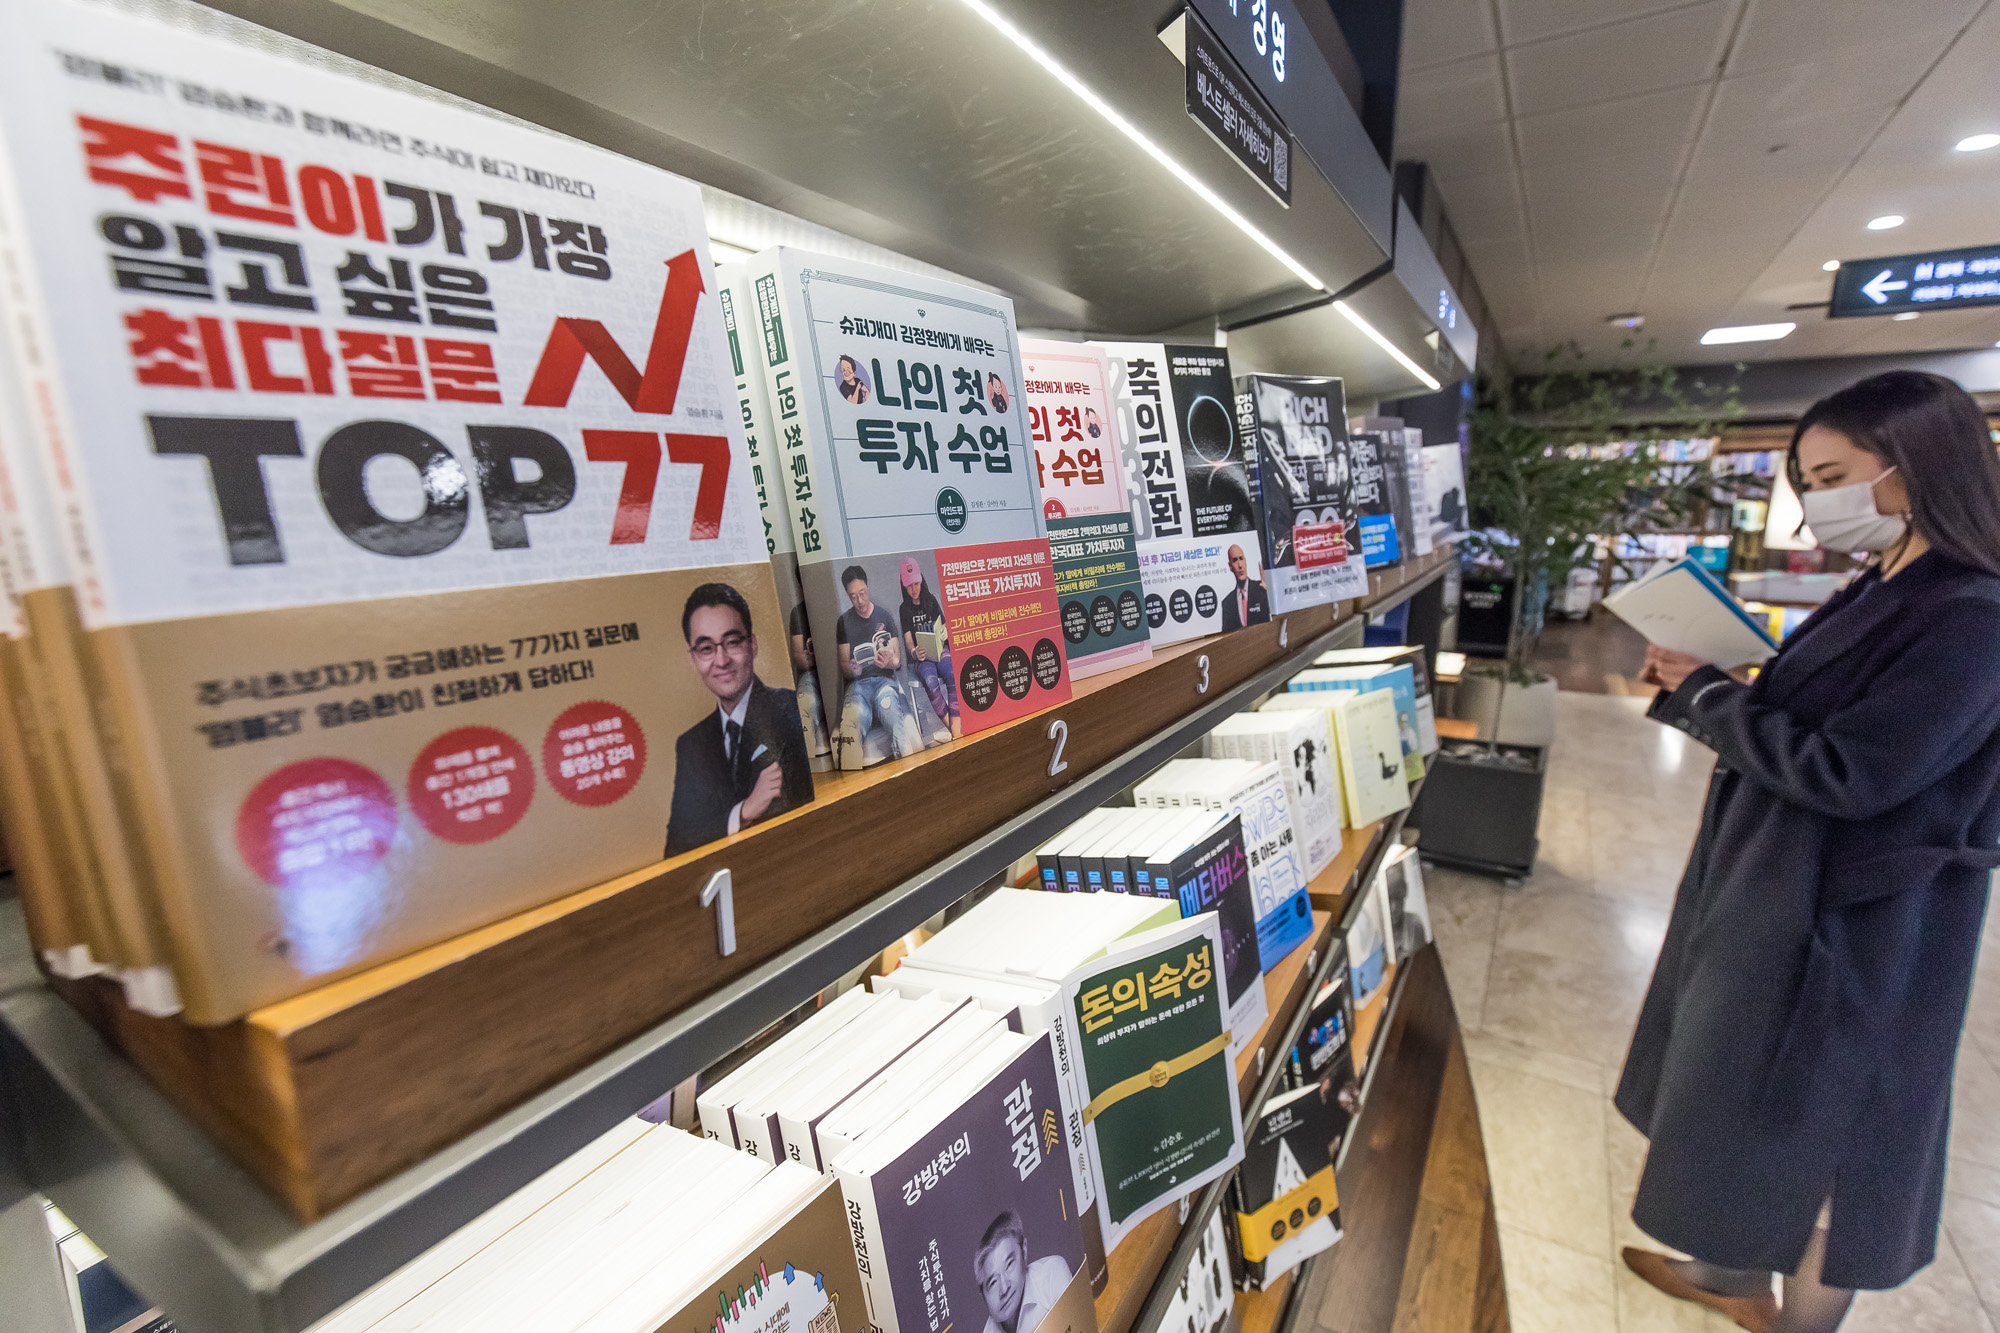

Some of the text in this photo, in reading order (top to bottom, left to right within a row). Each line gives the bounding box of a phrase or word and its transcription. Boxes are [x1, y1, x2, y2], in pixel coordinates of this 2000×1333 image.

[1197, 70, 1238, 139] 베스트셀러
[301, 110, 404, 155] 함께라면
[409, 137, 476, 170] 주식이
[480, 156, 521, 182] 쉽고
[523, 166, 596, 200] 재미있다
[75, 112, 613, 281] 주린이가 가장
[98, 212, 499, 332] 알고 싶은
[720, 292, 735, 331] 슈퍼개미
[765, 275, 780, 317] 슈퍼개미
[839, 315, 995, 358] 슈퍼개미 김정환에게 배우는
[122, 308, 503, 405] 최다질문
[871, 357, 988, 417] 나의 첫
[1064, 382, 1091, 395] 배우는
[1056, 406, 1084, 442] 첫
[1280, 396, 1329, 424] RICH
[775, 370, 822, 553] 나의 첫 투자 수업
[856, 418, 939, 475] 투자
[948, 425, 1013, 475] 수업
[1127, 358, 1183, 538] 축의 전환
[1052, 448, 1105, 487] 수업
[940, 504, 964, 517] 마인드편
[947, 495, 953, 504] 1
[1195, 504, 1232, 515] THE FUTURE OF
[1197, 513, 1229, 525] EVERYTHING
[1050, 538, 1125, 560] 한국대표 가치투자자
[1080, 526, 1102, 536] 2백억대
[1102, 524, 1118, 535] 자산을
[941, 552, 1046, 577] 7천만원으로 2백억대 자산을 이룬
[1084, 565, 1106, 576] 비밀리에
[1151, 554, 1158, 564] 후
[1160, 551, 1182, 564] 지금의
[1183, 548, 1204, 560] 세상은
[945, 571, 1041, 602] 한국대표 가치투자자
[950, 617, 967, 630] 그가
[967, 613, 990, 628] 딸에게
[990, 607, 1018, 622] 비밀리에
[1018, 601, 1042, 617] 전수했던
[952, 626, 1009, 647] 투자비책 총망라!
[194, 622, 640, 706] 주식초보자가 궁금해하는 77가지 질문에
[1195, 655, 1210, 694] 3
[316, 688, 426, 729] 염승환이
[430, 673, 523, 708] 친절하게
[527, 659, 595, 690] 답하다!
[605, 744, 636, 766] 강의
[1047, 719, 1070, 778] 2
[1260, 839, 1279, 861] 아는
[1278, 827, 1294, 848] 사람
[1179, 846, 1246, 919] 메타버스
[701, 866, 737, 957] 1
[1117, 1023, 1137, 1039] 부자가
[1138, 1015, 1158, 1031] 말하는
[1172, 1003, 1185, 1018] 대한
[1185, 999, 1198, 1012] 모든
[1054, 1015, 1083, 1148] 강방천의 관점
[1003, 1078, 1042, 1182] 관점
[1160, 1131, 1184, 1151] 김승호
[902, 1131, 971, 1207] 강방천의
[847, 1199, 873, 1279] 강방천의
[918, 1255, 939, 1332] 가치를 찾는 법
[928, 1238, 950, 1321] 주식투자 대가가
[765, 1301, 791, 1330] 시대에
[815, 1306, 833, 1328] NEWS
